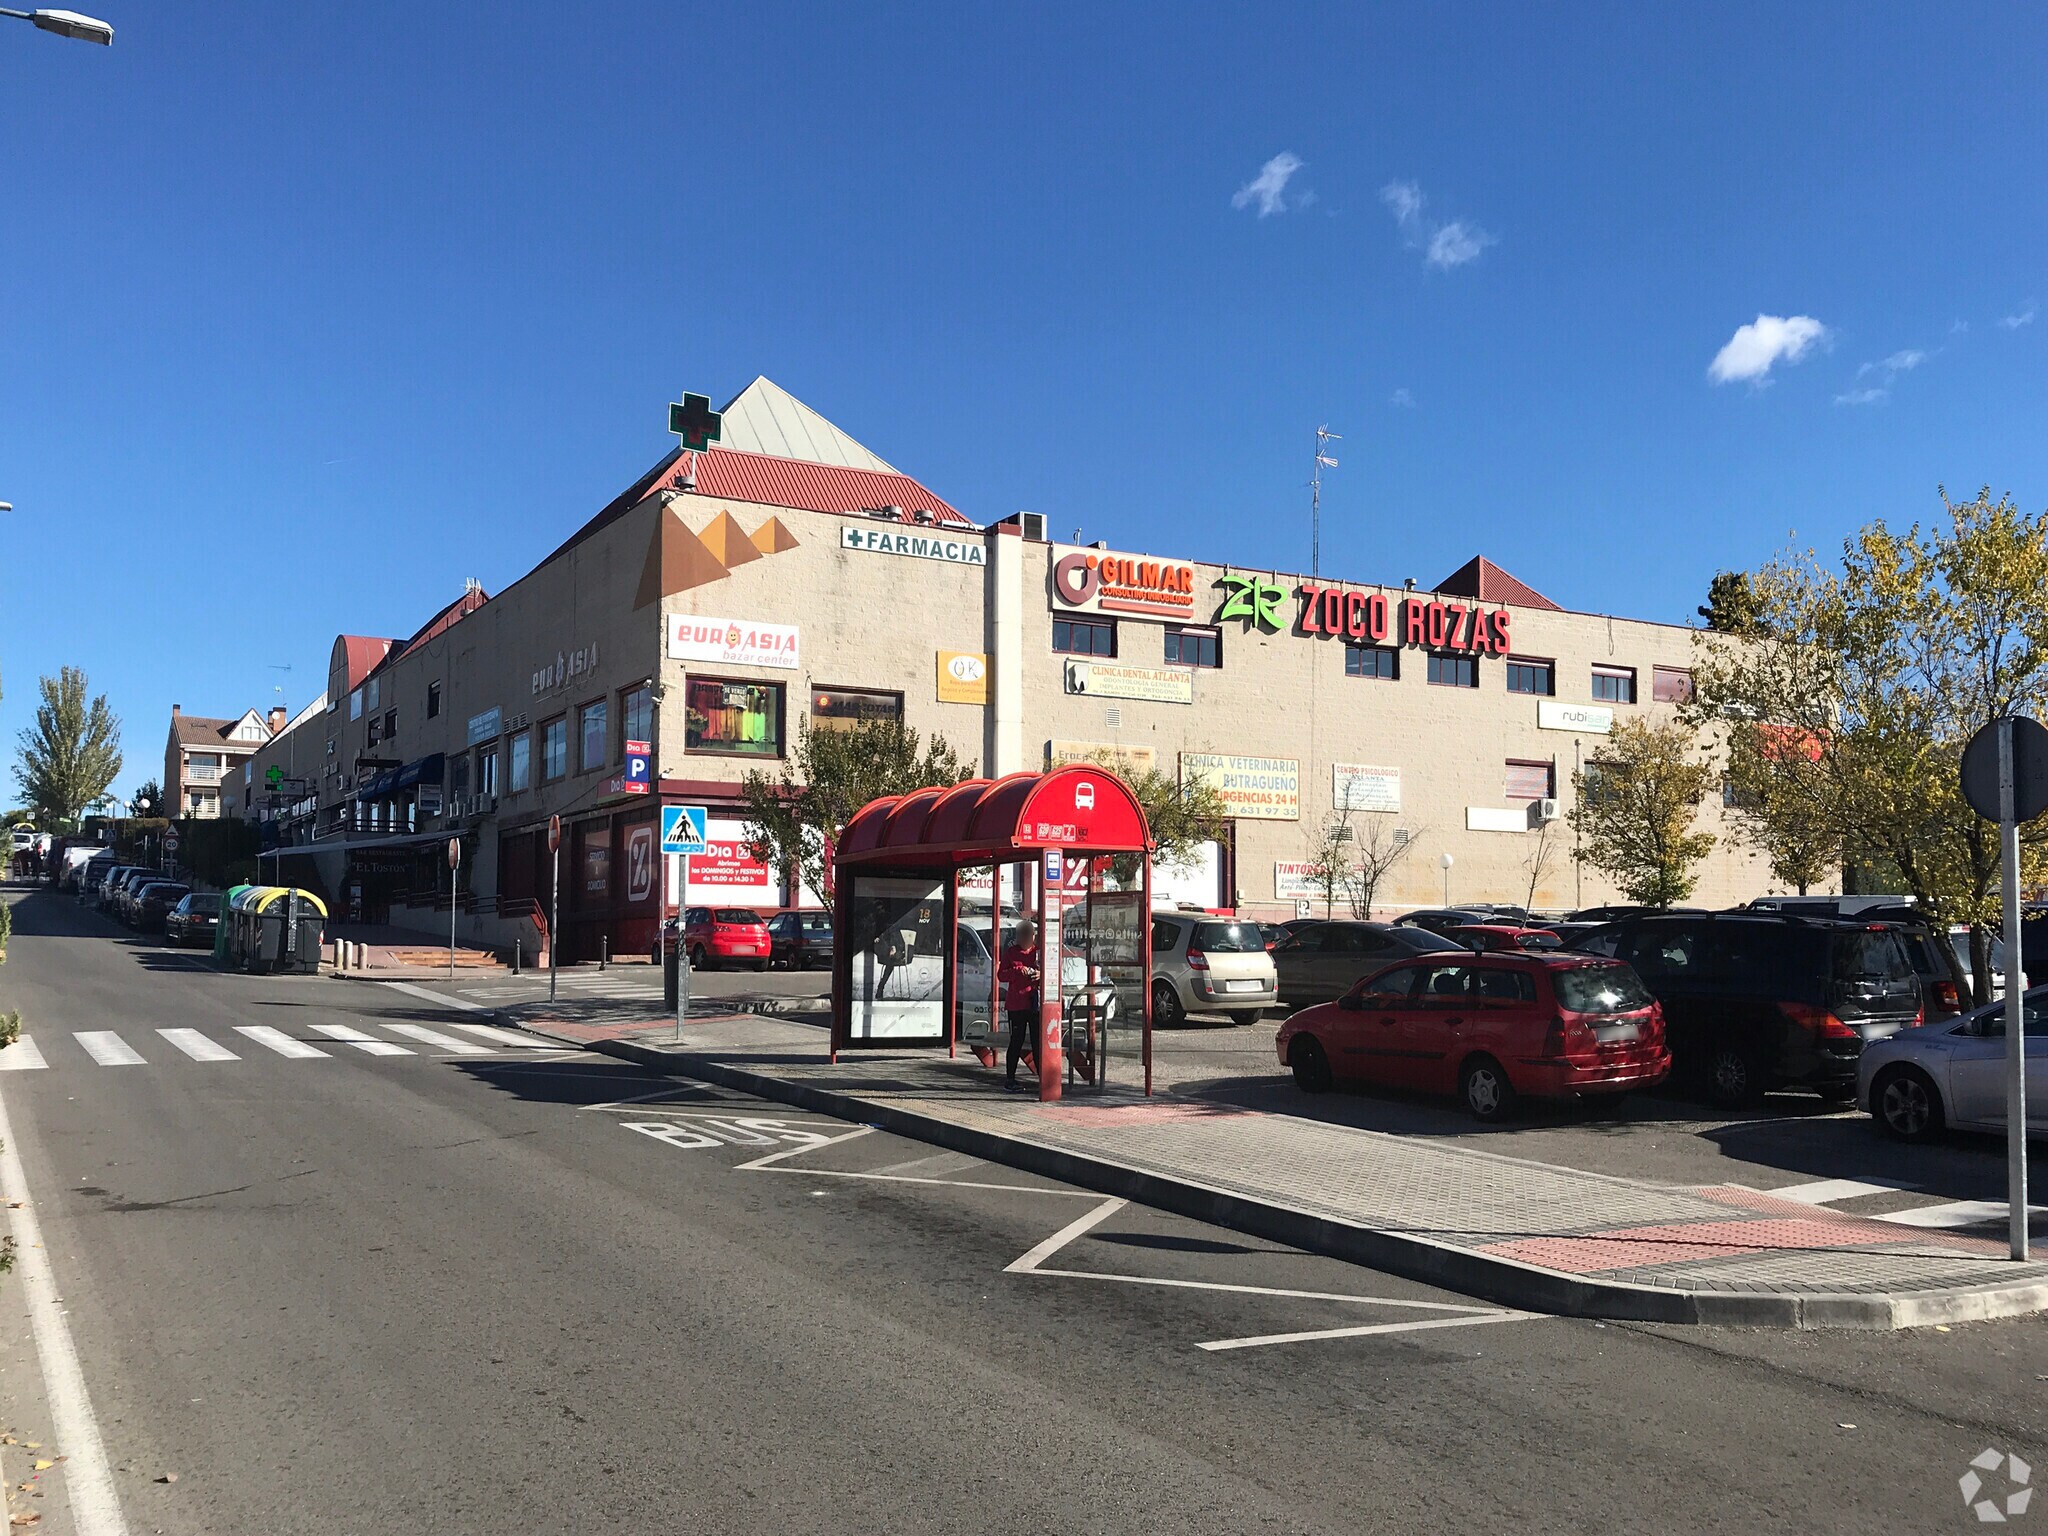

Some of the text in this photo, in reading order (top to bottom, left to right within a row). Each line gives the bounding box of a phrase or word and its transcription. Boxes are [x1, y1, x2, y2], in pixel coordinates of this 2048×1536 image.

[866, 531, 982, 562] FARMACIA
[1102, 556, 1194, 593] GILMAR
[1101, 586, 1146, 600] CONSULTING
[1302, 585, 1388, 640] ZOCO
[1407, 598, 1511, 654] ROZAS
[723, 650, 794, 666] bazar center
[1092, 665, 1190, 684] CLINICA DENTAL ATLANTA
[1229, 757, 1297, 773] VETERINARIA
[1275, 794, 1287, 805] 24
[1290, 794, 1297, 805] H
[1240, 806, 1260, 815] 631
[1265, 807, 1279, 816] 97
[1283, 808, 1297, 817] 35
[701, 867, 734, 875] DOMINGOS
[740, 868, 766, 876] FESTIVOS
[919, 908, 931, 919] 18
[619, 1118, 833, 1149] BUS
